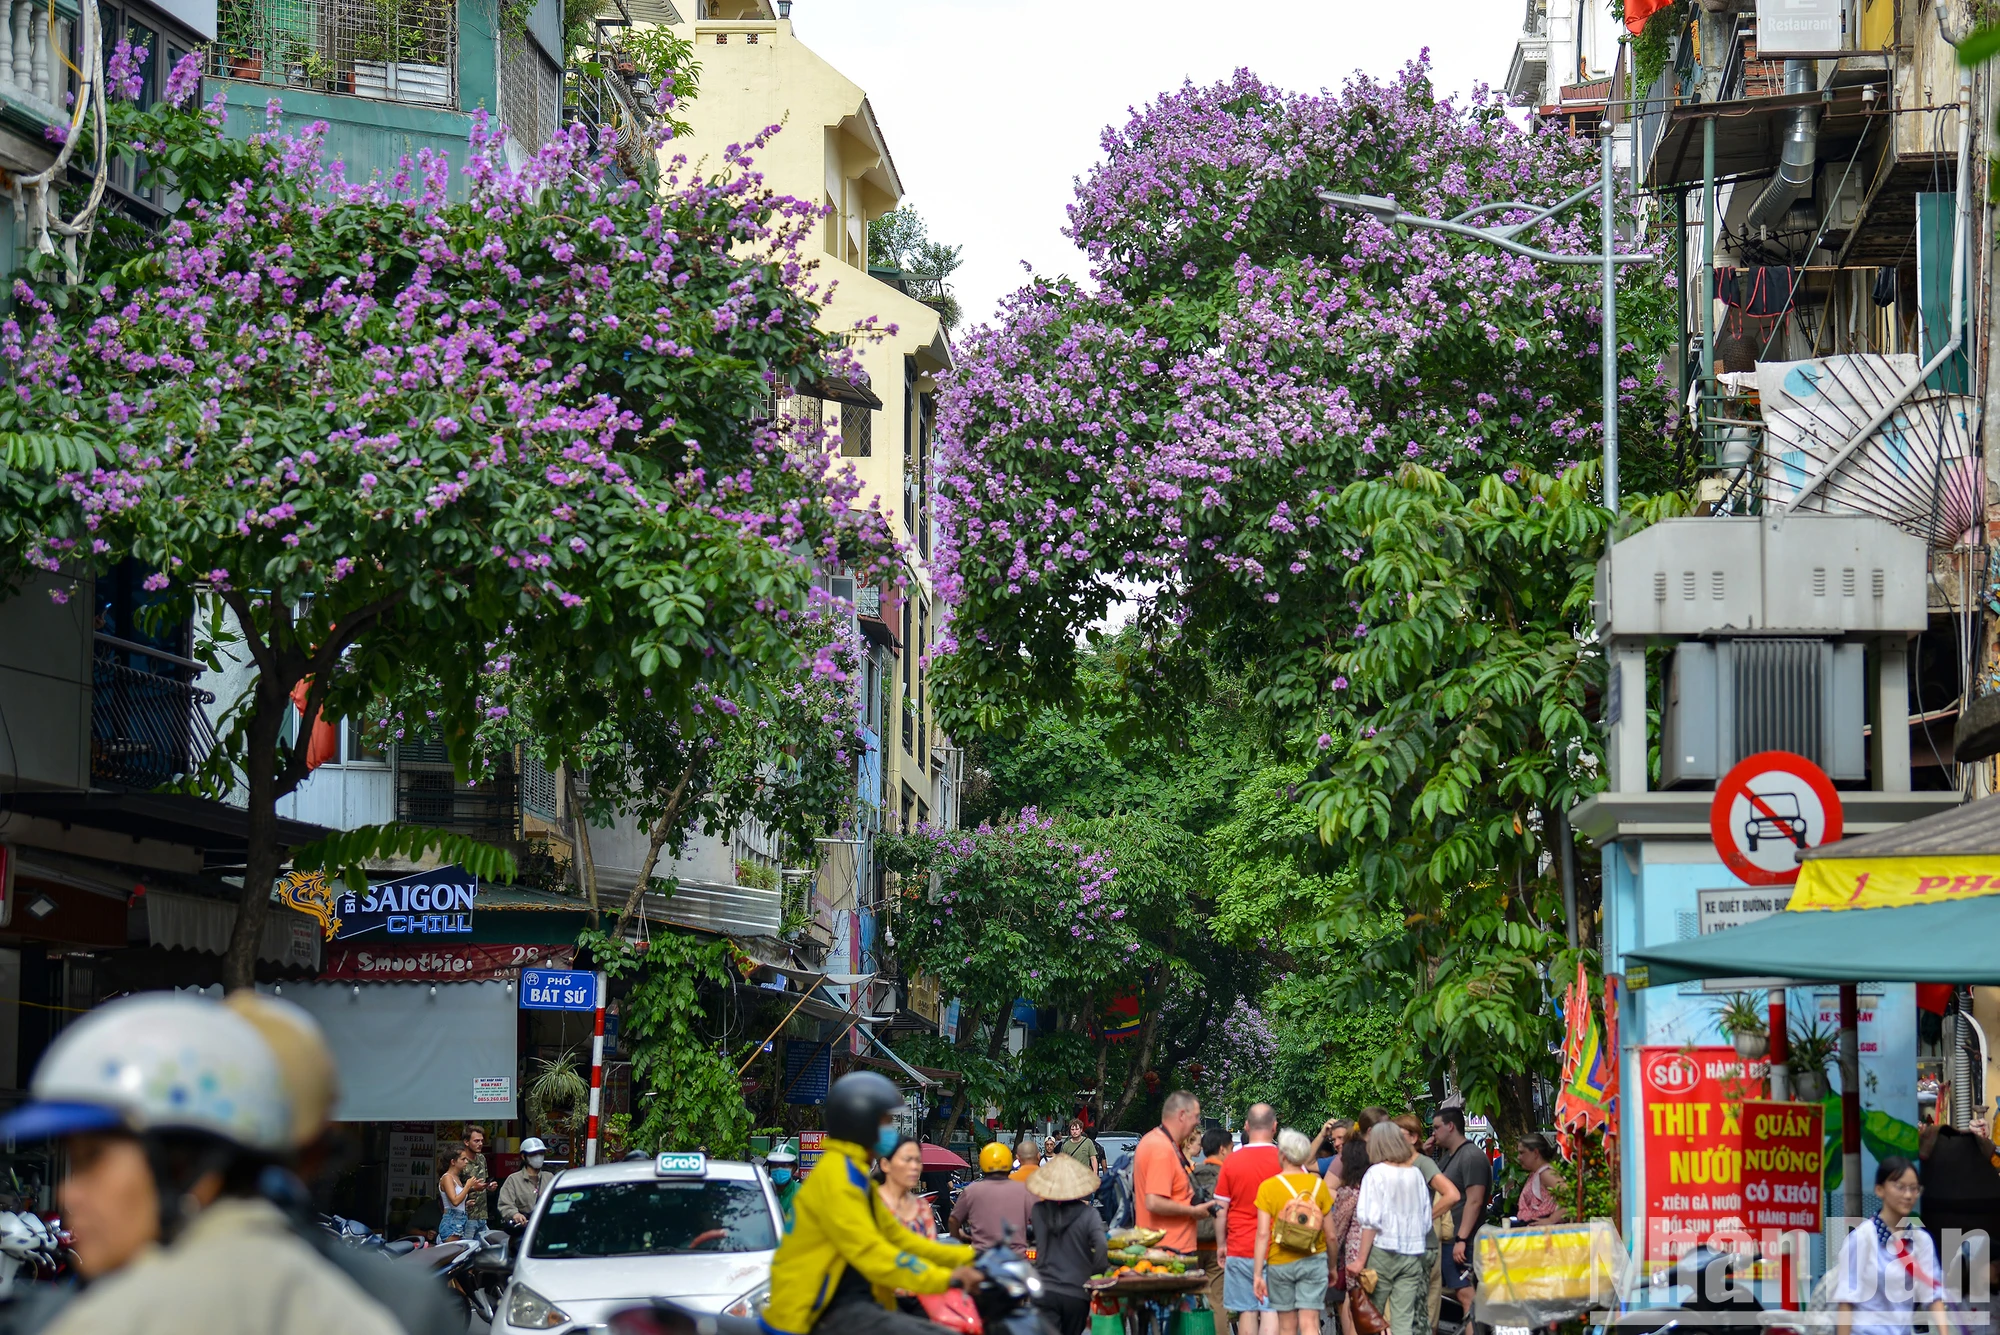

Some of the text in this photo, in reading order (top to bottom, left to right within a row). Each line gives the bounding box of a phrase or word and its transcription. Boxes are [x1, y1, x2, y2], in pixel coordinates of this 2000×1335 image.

[1767, 16, 1833, 32] Restaurant
[361, 884, 475, 913] SAIGON
[1705, 901, 1716, 914] XE
[1718, 896, 1740, 913] QUÉT
[386, 914, 474, 934] CHILL
[357, 951, 466, 973] Smoothie
[511, 946, 540, 964] 28
[547, 974, 572, 986] PHỐ
[530, 986, 588, 1005] BÁT SỨ
[1654, 1058, 1683, 1086] SỐ
[1649, 1102, 1711, 1143] THỊT
[1754, 1109, 1811, 1141] QUÁN
[403, 1135, 425, 1143] BEER
[801, 1133, 823, 1143] MONEY
[662, 1156, 700, 1170] Grab
[1669, 1144, 1742, 1184] NƯỚ
[1744, 1144, 1820, 1173] NƯỚNG
[1745, 1178, 1818, 1205] CÓ KHÓI
[1661, 1193, 1690, 1211] XIÊN
[1691, 1192, 1710, 1211] GÀ
[1747, 1209, 1754, 1224] 1
[1757, 1207, 1787, 1225] HÀNG
